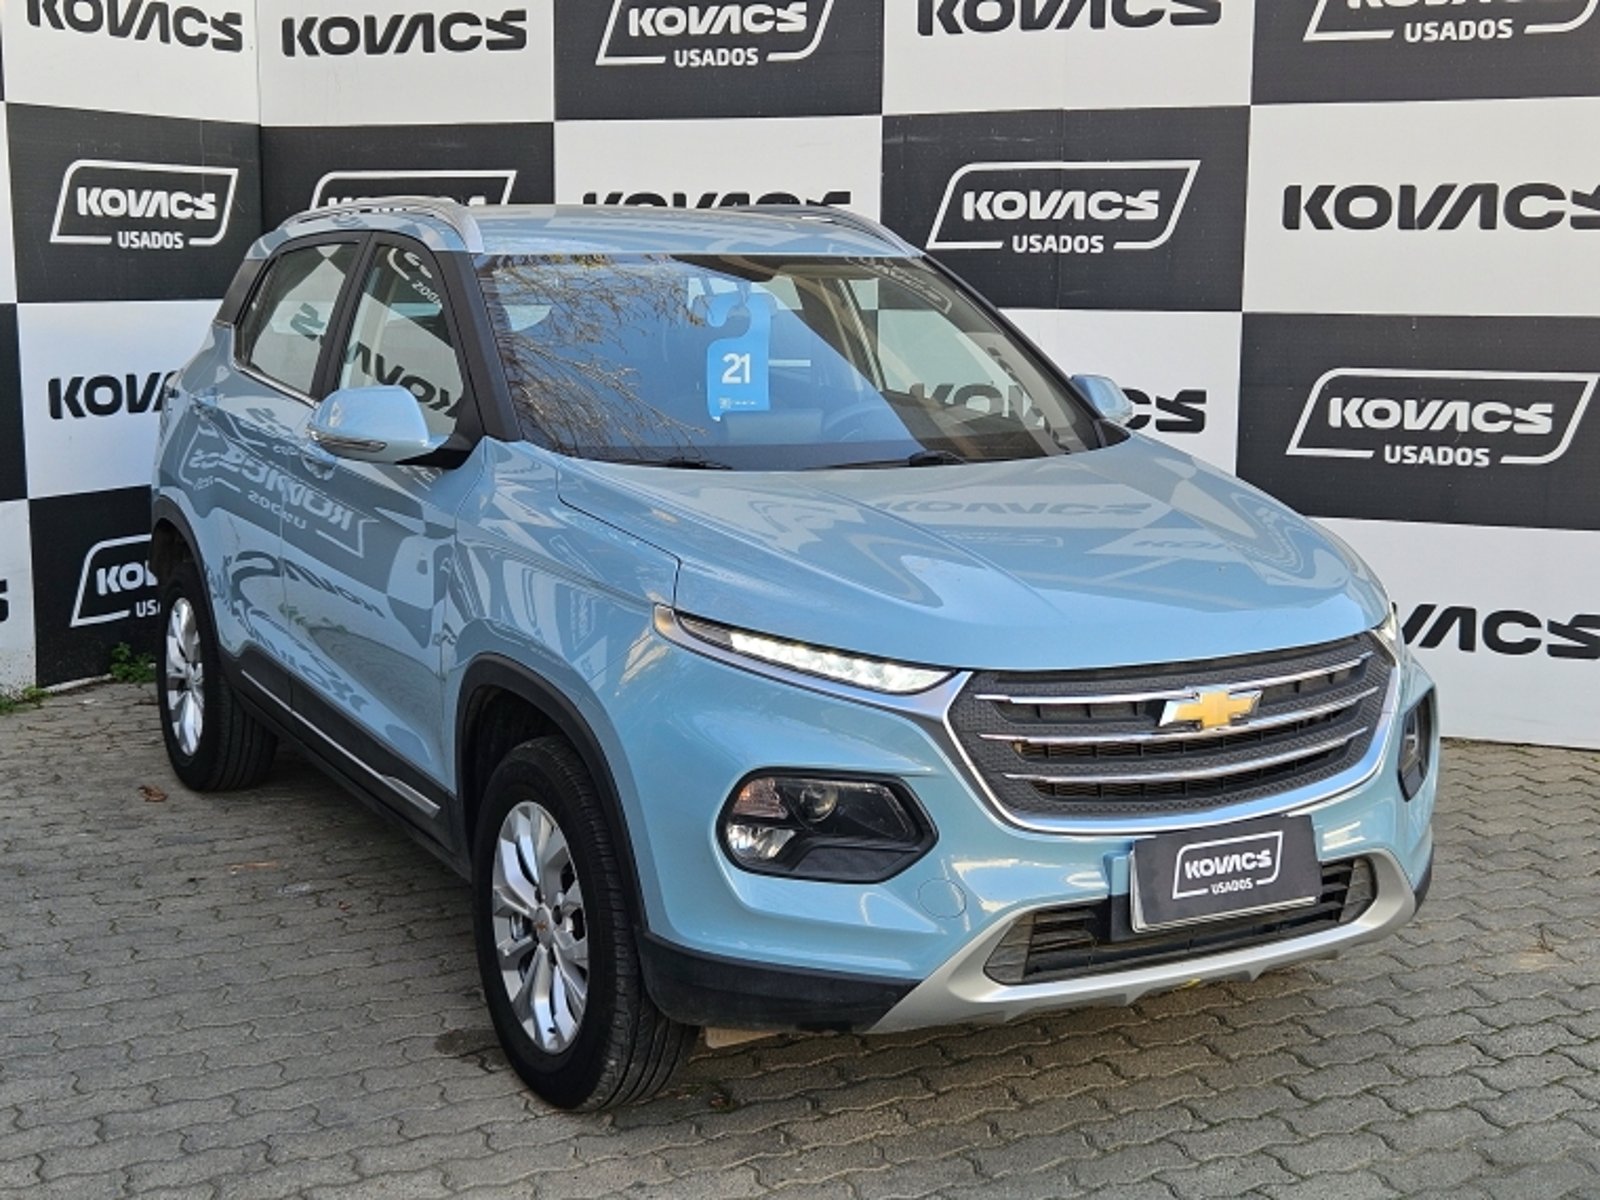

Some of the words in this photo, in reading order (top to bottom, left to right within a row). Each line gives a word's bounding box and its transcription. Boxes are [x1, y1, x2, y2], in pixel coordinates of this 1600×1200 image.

[27, 0, 243, 53] KOVACS
[281, 9, 528, 58] KOVACS
[628, 1, 808, 37] KOVACS
[1404, 18, 1514, 43] USADOS
[674, 47, 759, 68] USADOS
[76, 186, 217, 220] KOVACS
[962, 189, 1160, 221] KOVACS
[117, 230, 184, 250] USADOS
[1012, 234, 1104, 254] USADOS
[721, 352, 751, 384] 21
[1328, 397, 1554, 435] KOVACS
[1384, 444, 1491, 467] USADOS
[1184, 848, 1273, 880] KOVACS
[1210, 877, 1254, 895] USADOS
